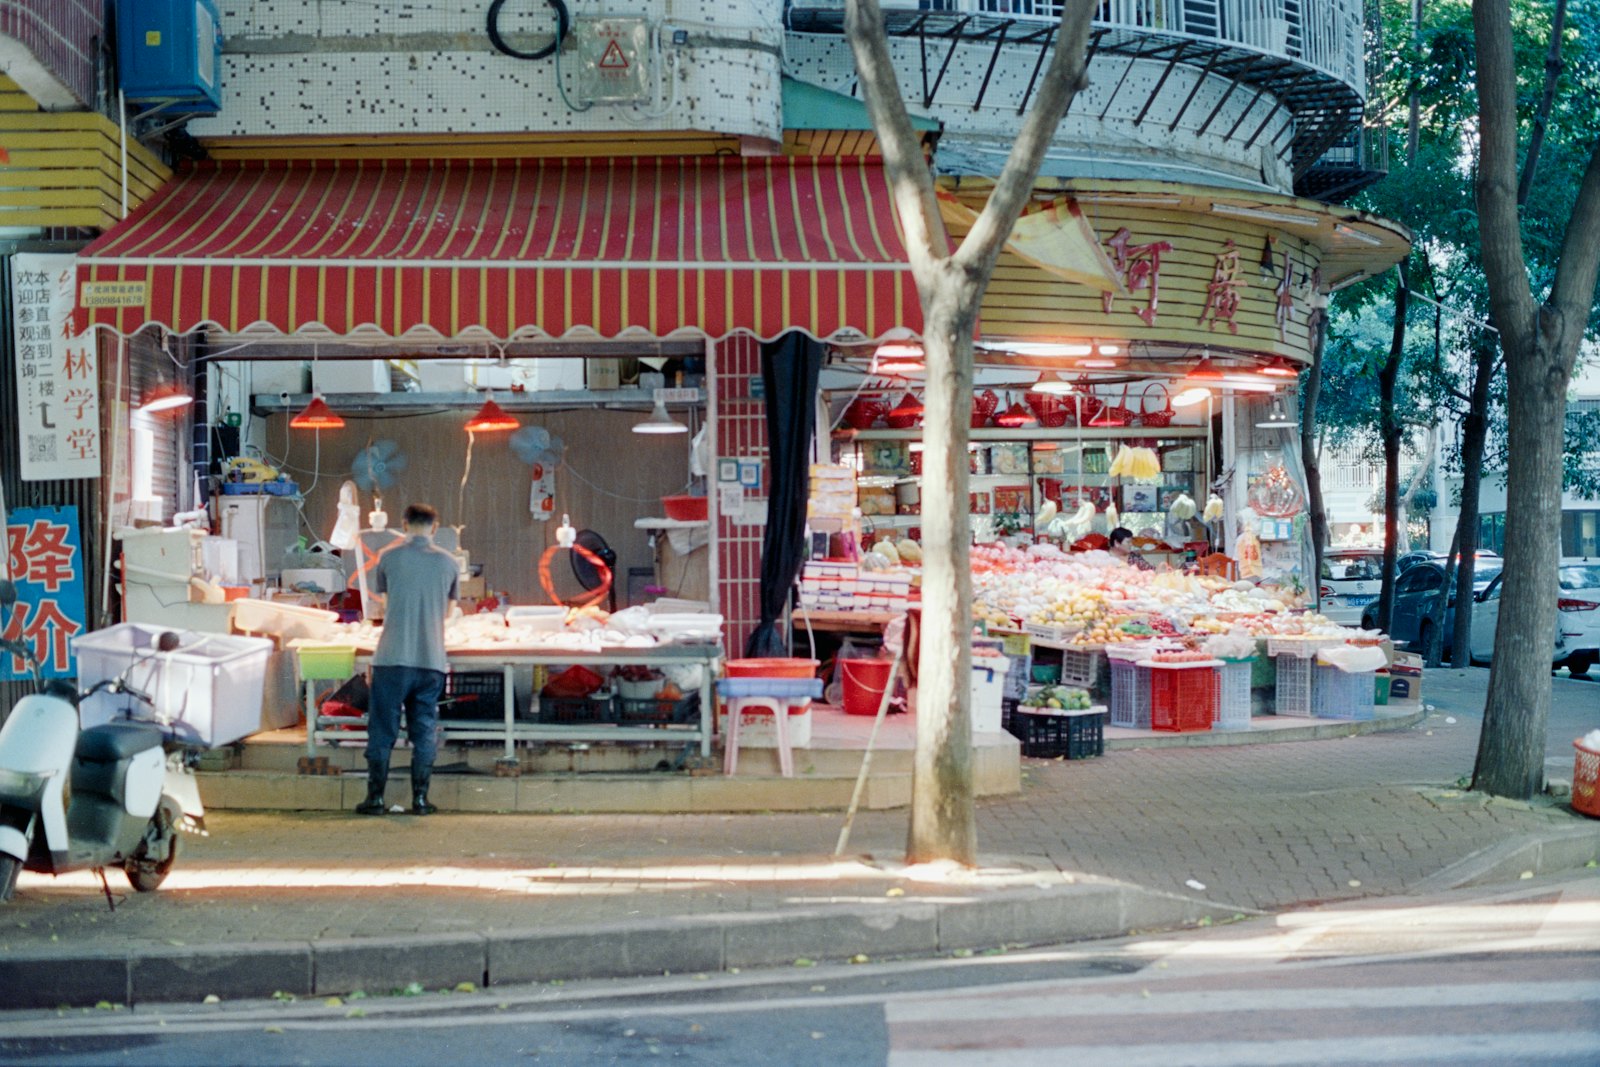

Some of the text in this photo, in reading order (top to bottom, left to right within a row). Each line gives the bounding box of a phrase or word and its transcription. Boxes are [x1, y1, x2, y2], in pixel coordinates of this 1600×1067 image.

[34, 270, 55, 397] 本店直通到二楼
[58, 269, 97, 460] 林学堂
[2, 519, 82, 673] 降价
